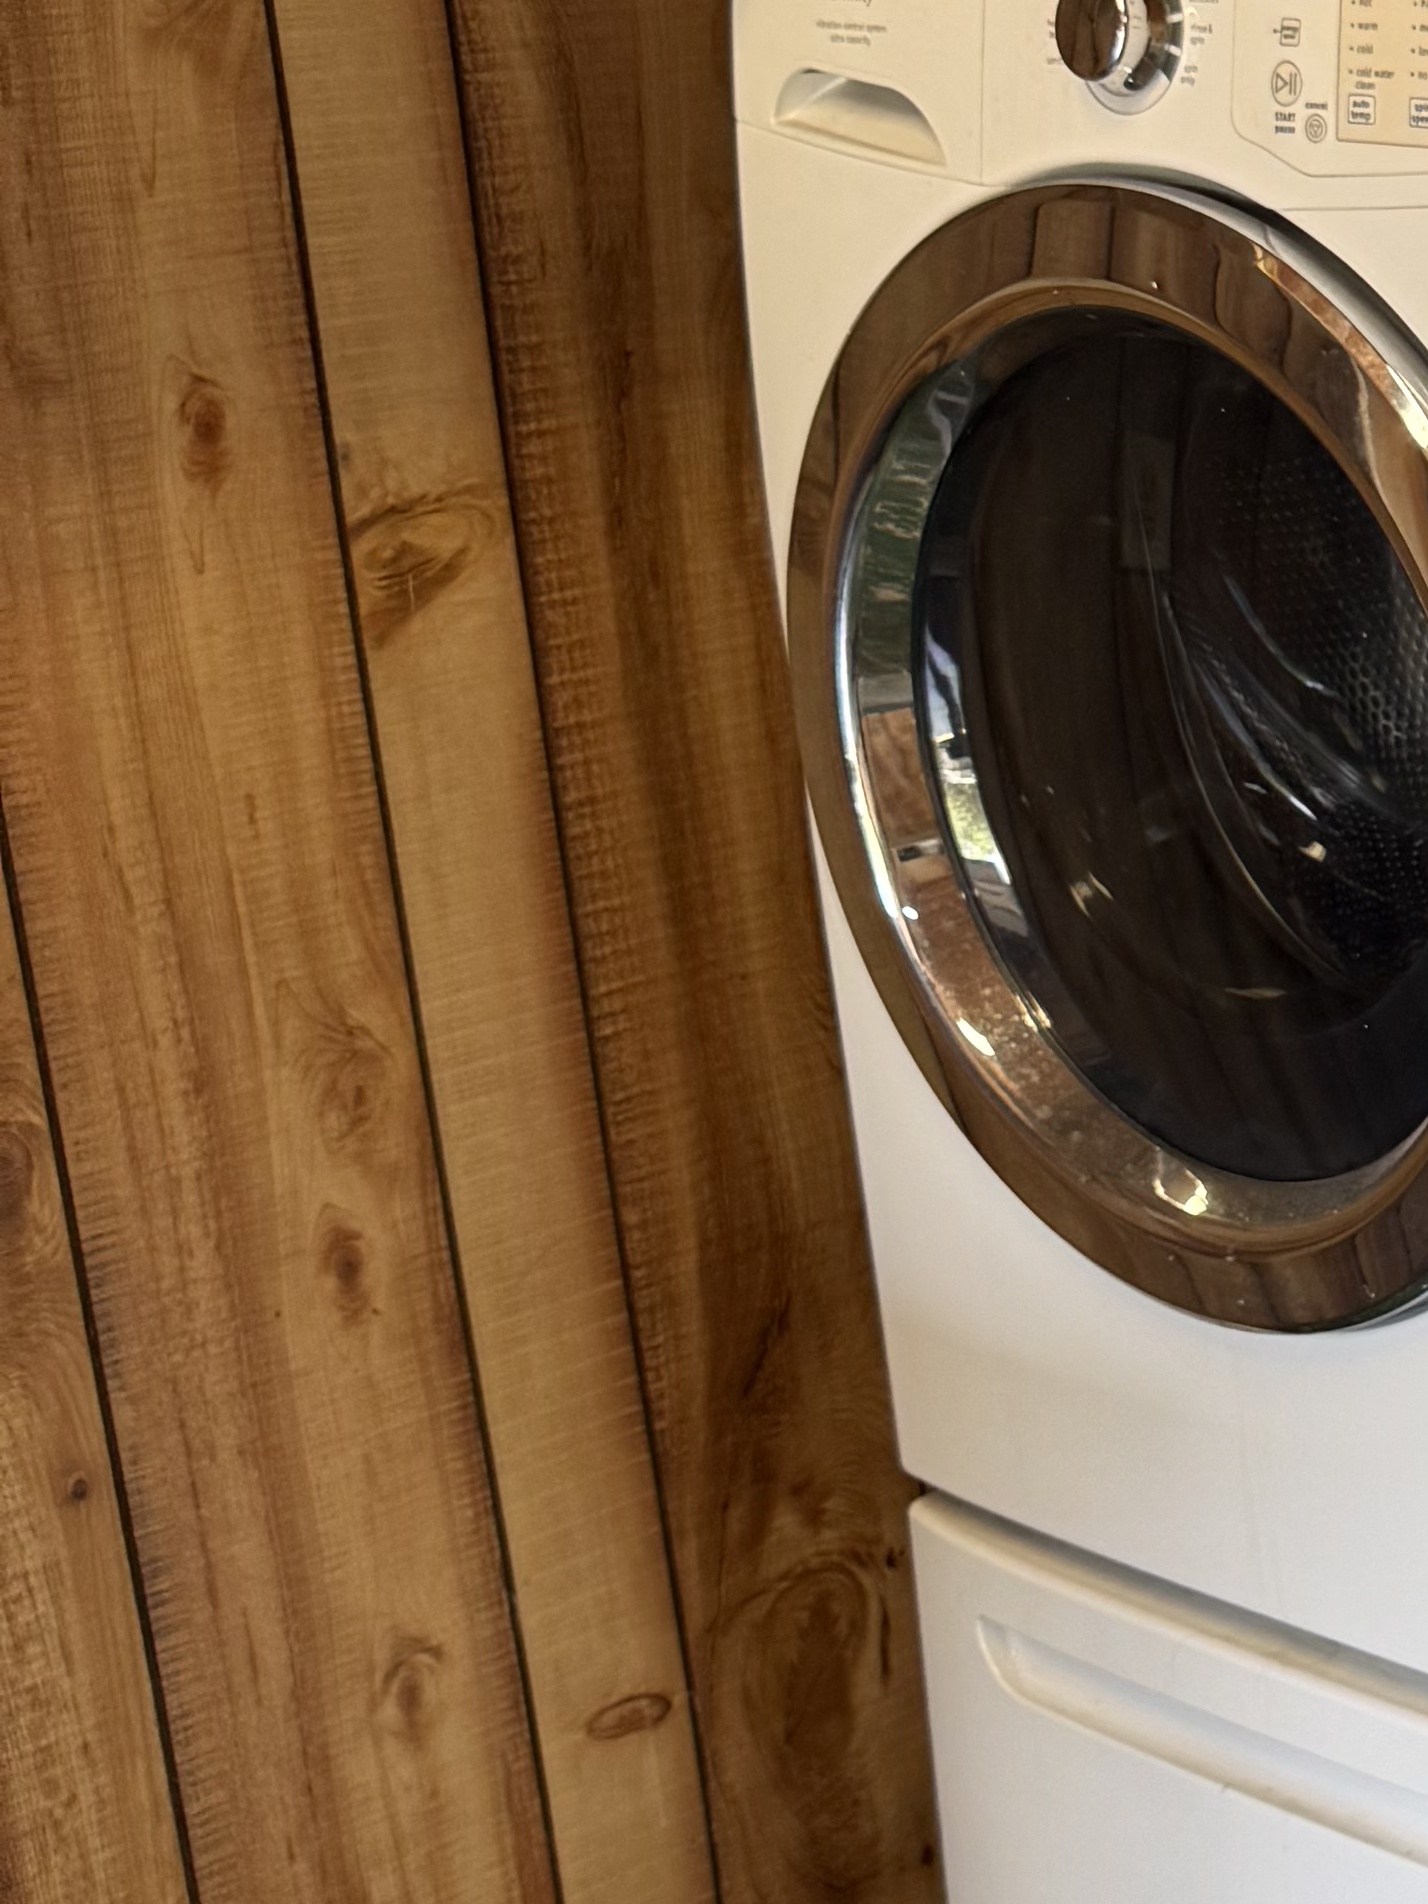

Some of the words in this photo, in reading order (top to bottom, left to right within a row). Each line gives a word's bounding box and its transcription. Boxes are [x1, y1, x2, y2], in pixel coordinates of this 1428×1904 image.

[1358, 22, 1378, 31] warm
[1357, 44, 1373, 54] cold
[1356, 68, 1372, 78] cold
[1374, 70, 1395, 80] water
[1418, 71, 1428, 81] no
[1352, 100, 1370, 109] auto
[1275, 111, 1296, 122] START
[1351, 110, 1371, 122] temp
